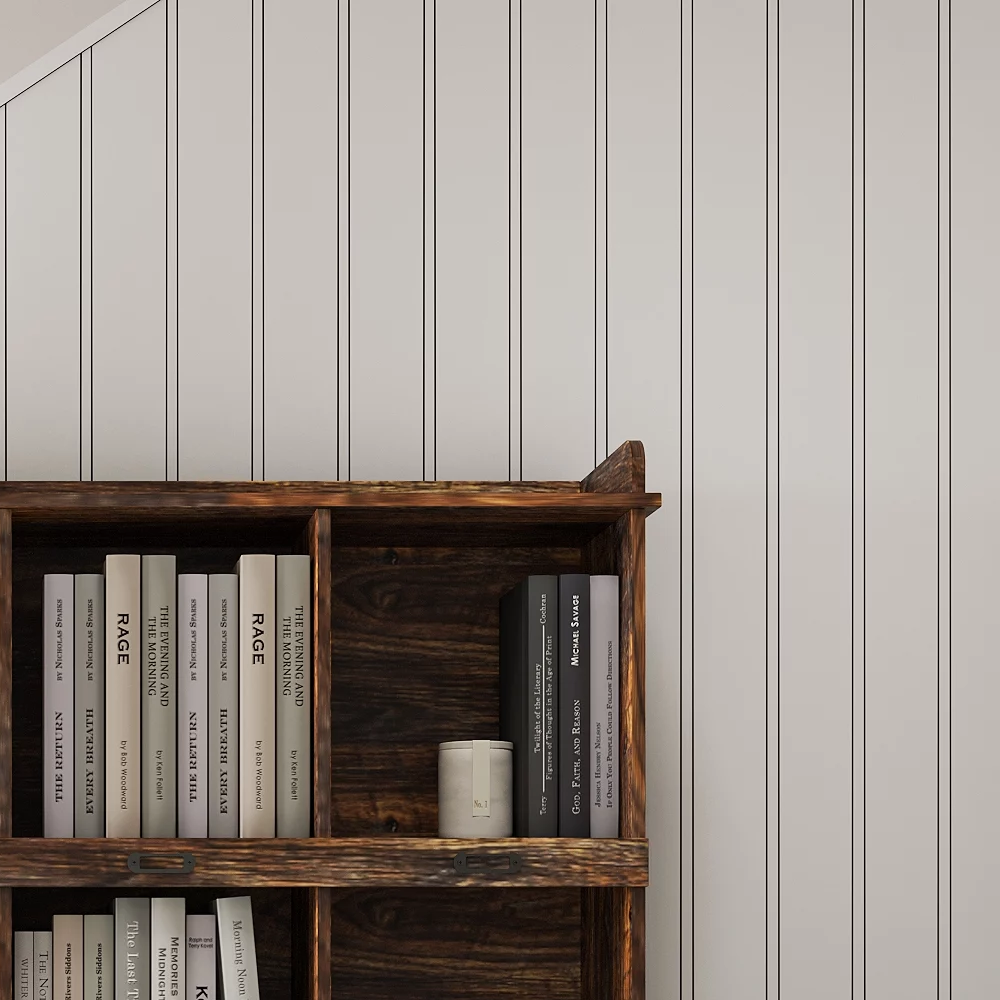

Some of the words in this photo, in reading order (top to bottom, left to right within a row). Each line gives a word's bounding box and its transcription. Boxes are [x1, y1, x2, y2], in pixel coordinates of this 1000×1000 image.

[117, 613, 130, 665] RAGE
[148, 616, 157, 639] THE
[160, 605, 169, 628] THE
[252, 613, 265, 665] RAGE
[148, 642, 157, 696] MORNING
[160, 631, 169, 680] EVENING
[160, 682, 169, 707] AND
[55, 712, 63, 770] RETURN
[86, 708, 94, 764] BREATH
[55, 774, 63, 803] THE
[86, 769, 94, 814] EVERY
